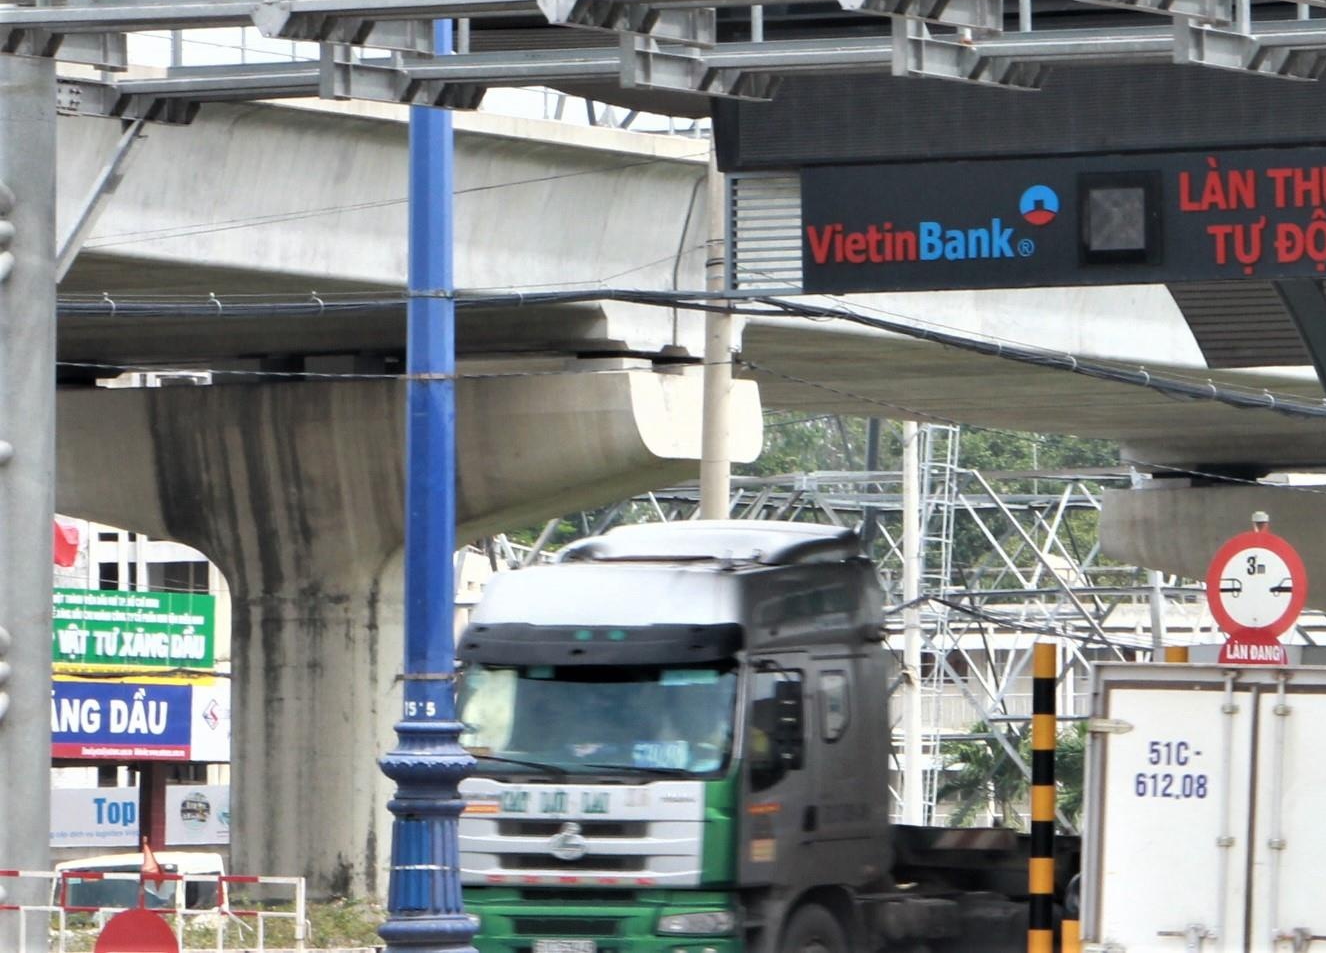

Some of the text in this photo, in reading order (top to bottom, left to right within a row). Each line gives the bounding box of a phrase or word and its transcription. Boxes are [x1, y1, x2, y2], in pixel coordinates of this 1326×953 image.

[1178, 156, 1261, 213] LÀN
[806, 218, 1015, 265] VietinBank
[1207, 219, 1265, 275] TỰ
[1226, 640, 1281, 661] LÀN ĐANG
[109, 688, 168, 735] DẦU
[1135, 773, 1207, 799] 612.08
[93, 797, 136, 826] Top
